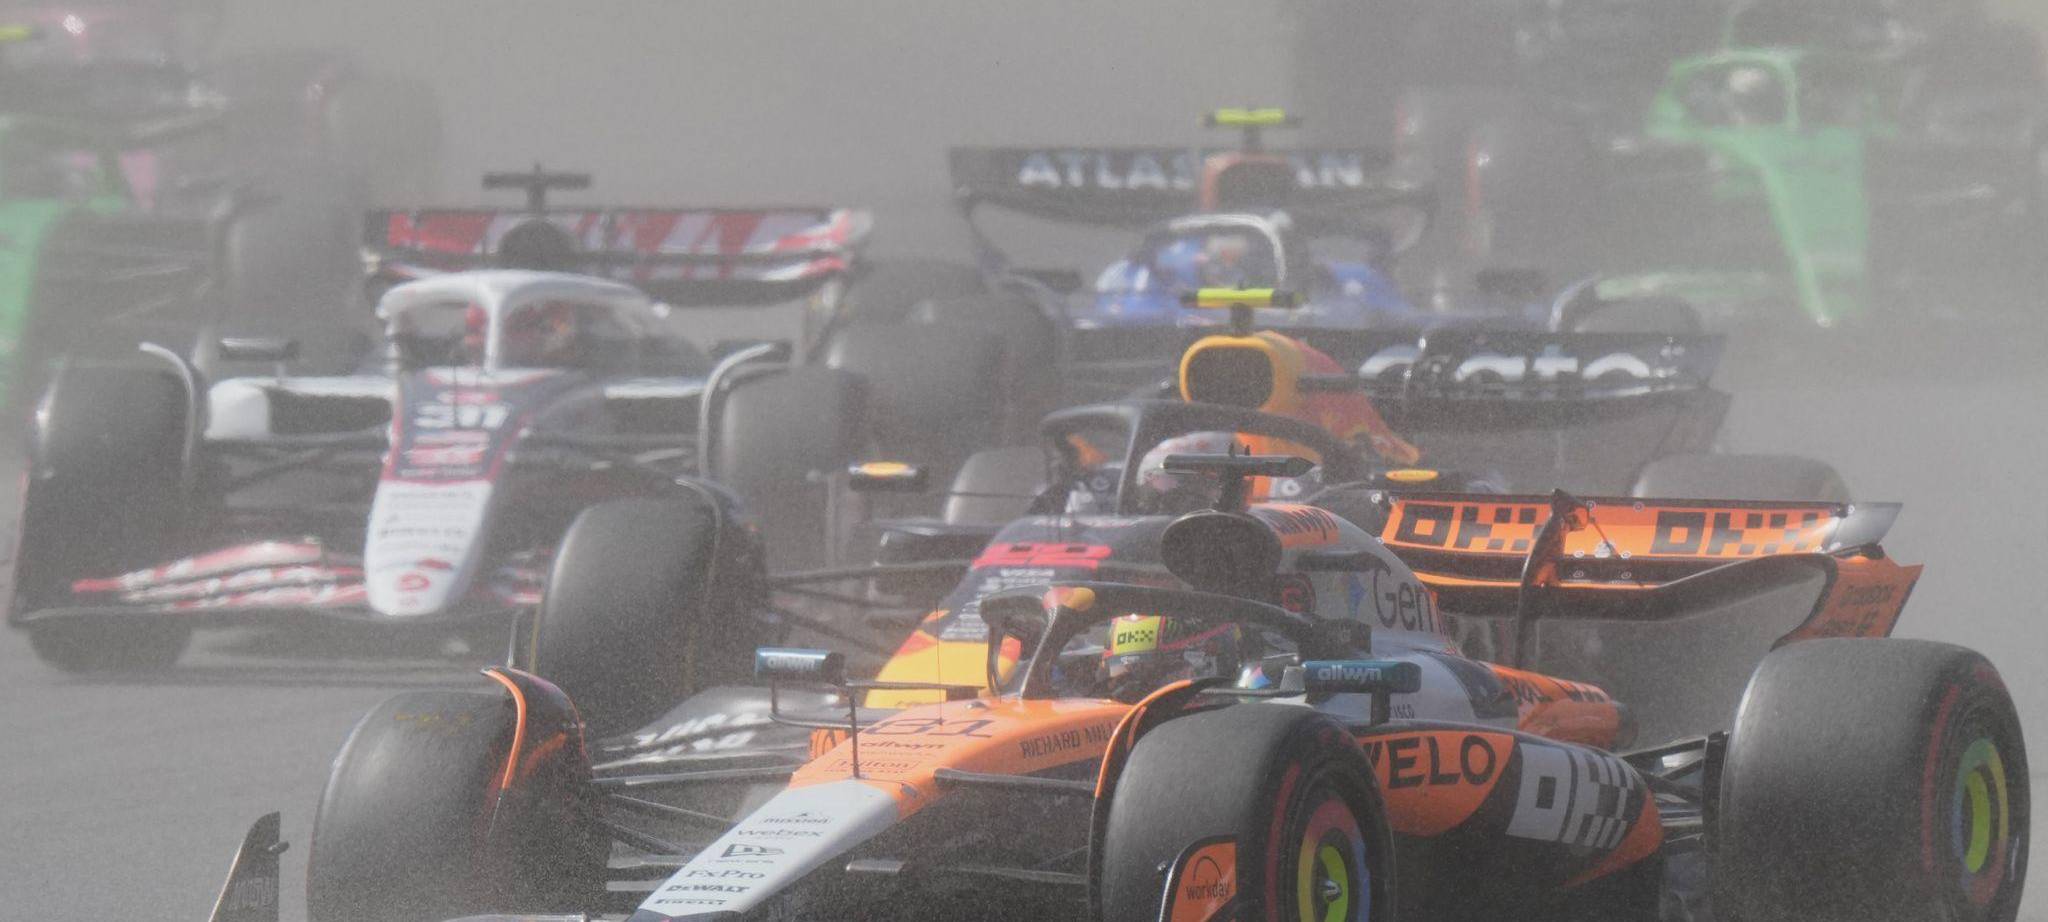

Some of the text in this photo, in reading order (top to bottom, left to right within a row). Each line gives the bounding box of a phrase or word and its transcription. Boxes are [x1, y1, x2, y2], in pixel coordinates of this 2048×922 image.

[1018, 150, 1363, 190] ATLASN
[1317, 664, 1383, 684] allwyn
[860, 740, 946, 751] allwyn
[1019, 729, 1081, 759] RICHARD
[738, 829, 824, 838] webex
[686, 869, 767, 879] FxPro
[1185, 878, 1230, 900] workday
